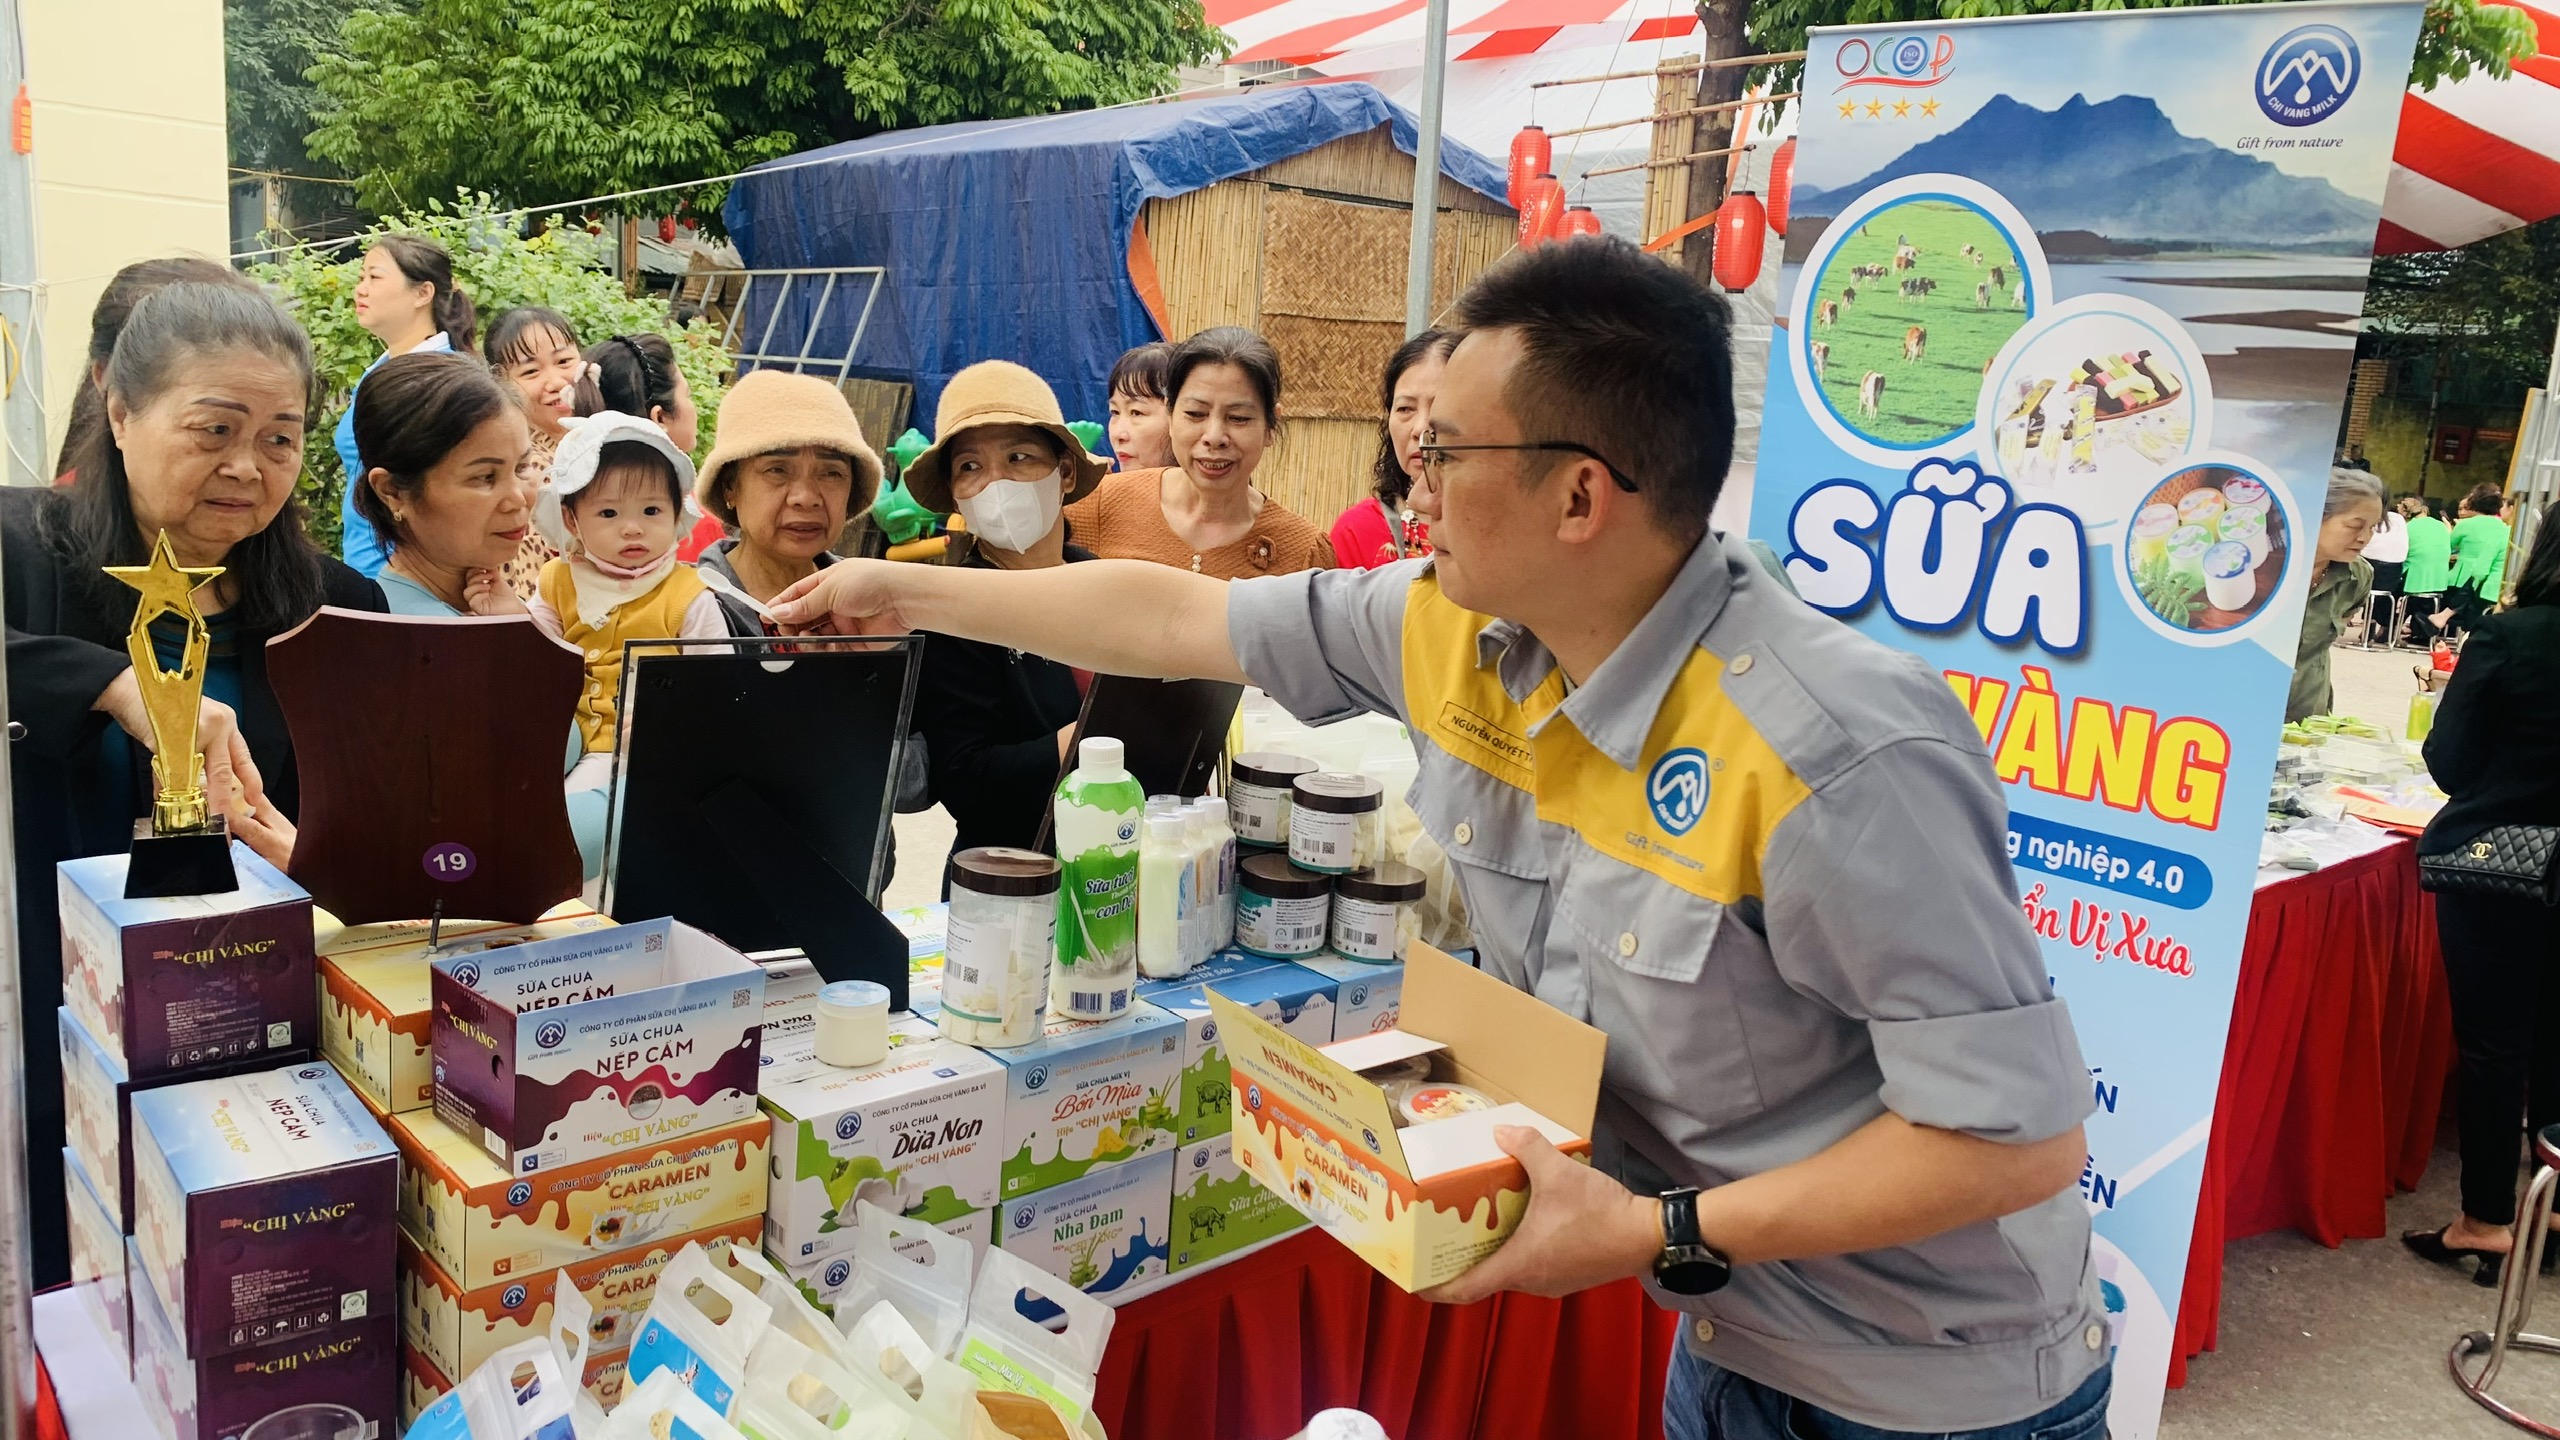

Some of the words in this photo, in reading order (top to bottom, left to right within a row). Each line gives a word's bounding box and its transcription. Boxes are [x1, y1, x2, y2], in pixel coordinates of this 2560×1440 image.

[1836, 33, 1956, 78] OCOP
[2268, 97, 2284, 112] CHI
[2283, 107, 2310, 119] VANG
[2312, 94, 2337, 115] MILK
[2237, 136, 2261, 149] Gift
[2263, 136, 2296, 150] from
[2299, 137, 2344, 148] nature
[1783, 457, 2089, 656] SỮA
[1451, 715, 1492, 742] NGUYỄN
[1491, 737, 1524, 759] QUYẾT
[433, 852, 467, 872] 19
[2028, 835, 2131, 884] nghiệp
[2136, 860, 2185, 894] 4.0
[1085, 878, 1111, 896] Sữa
[1095, 901, 1121, 919] con
[174, 949, 214, 964] “CHỊ
[218, 939, 276, 959] VÀNG”
[2069, 898, 2113, 962] Vị
[2113, 911, 2196, 978] Xưa
[517, 962, 527, 970] TY
[541, 955, 562, 966] PHẦN
[563, 952, 579, 962] SỮA
[579, 950, 593, 959] CHỊ
[593, 943, 613, 956] VÀNG
[614, 943, 624, 952] BA
[517, 979, 547, 995] SỮA
[551, 970, 593, 989] CHUA
[579, 1023, 601, 1034] CÔNG
[603, 1021, 613, 1029] TY
[626, 1014, 647, 1025] PHẦN
[648, 1010, 663, 1020] SỮA
[664, 1008, 677, 1017] CHỊ
[678, 1002, 698, 1014] VÀNG
[698, 1001, 708, 1010] BA
[450, 1014, 468, 1037] “CHỊ
[469, 1023, 498, 1049] VÀNG”
[610, 1031, 639, 1048] SỮA
[643, 1023, 684, 1040] CHUA
[597, 1050, 639, 1075] NẾP
[847, 1071, 885, 1084] "CHỊ
[889, 1058, 933, 1075] VÀNG"
[1261, 1044, 1338, 1103] CARAMEN
[971, 1085, 979, 1093] BA
[1090, 1077, 1109, 1087] CHUA
[266, 1098, 294, 1117] NẾP
[1052, 1088, 1096, 1122] Bốn
[1096, 1082, 1143, 1107] Mùa
[305, 1108, 326, 1126] CHUA
[602, 1126, 641, 1147] “CHỊ
[645, 1112, 699, 1136] VÀNG”
[911, 1113, 939, 1127] CHUA
[1076, 1114, 1099, 1129] “CHỊ
[1103, 1105, 1137, 1123] VÀNG”
[891, 1128, 936, 1159] Dừa
[915, 1153, 940, 1168] "CHỊ
[942, 1141, 977, 1159] VÀNG"
[550, 1179, 579, 1194] CÔNG
[582, 1174, 597, 1185] TY
[685, 1147, 712, 1162] VÀNG
[713, 1144, 727, 1154] BA
[727, 1140, 738, 1151] VÌ
[1304, 1147, 1369, 1202] CARAMEN
[609, 1162, 711, 1200] CARAMEN
[243, 1214, 287, 1233] “CHỊ
[292, 1202, 355, 1225] VÀNG”
[1073, 1203, 1098, 1217] CHUA
[1227, 1195, 1251, 1215] Sữa
[1053, 1221, 1084, 1244] Nha
[1089, 1208, 1124, 1231] Đam
[604, 1273, 658, 1300] CARA
[256, 1354, 298, 1374] “CHỊ
[303, 1335, 361, 1363] VÀNG”
[1000, 1363, 1013, 1382] Mix
